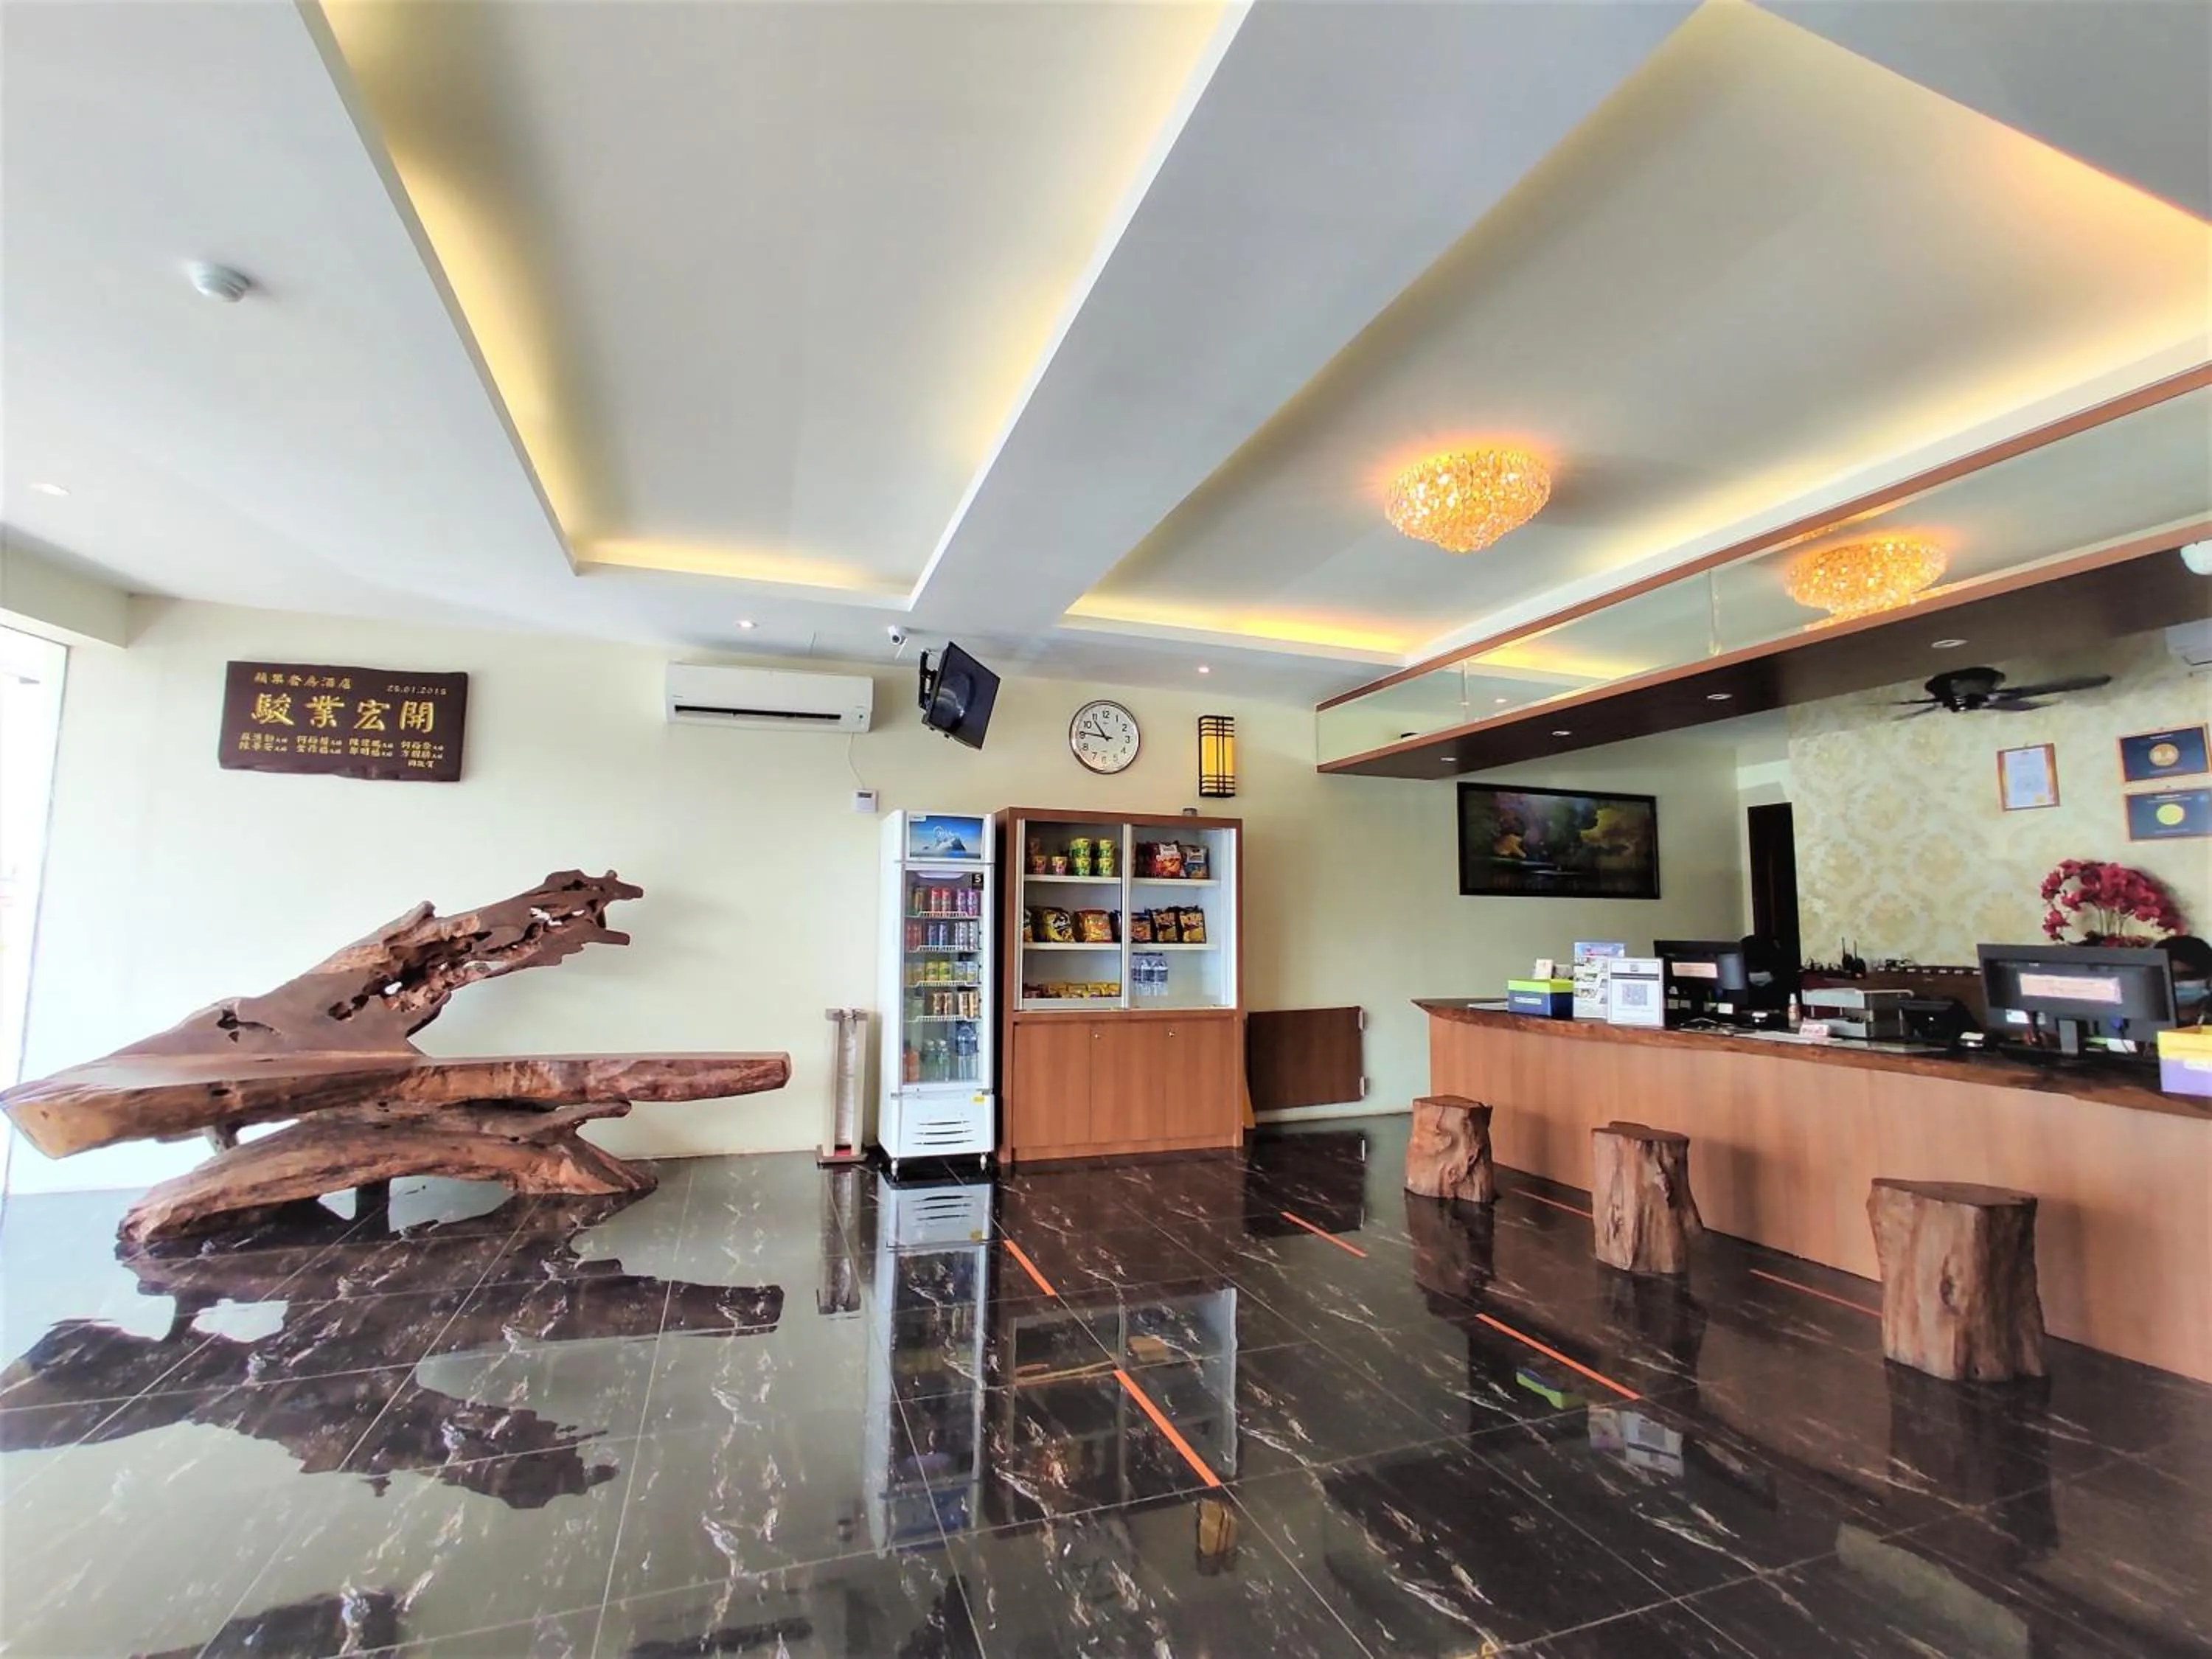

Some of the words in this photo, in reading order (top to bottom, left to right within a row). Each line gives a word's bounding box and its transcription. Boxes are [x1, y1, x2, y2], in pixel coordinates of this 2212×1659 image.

[1102, 710, 1110, 718] 12
[1115, 714, 1119, 723] 1
[1121, 723, 1127, 731] 2
